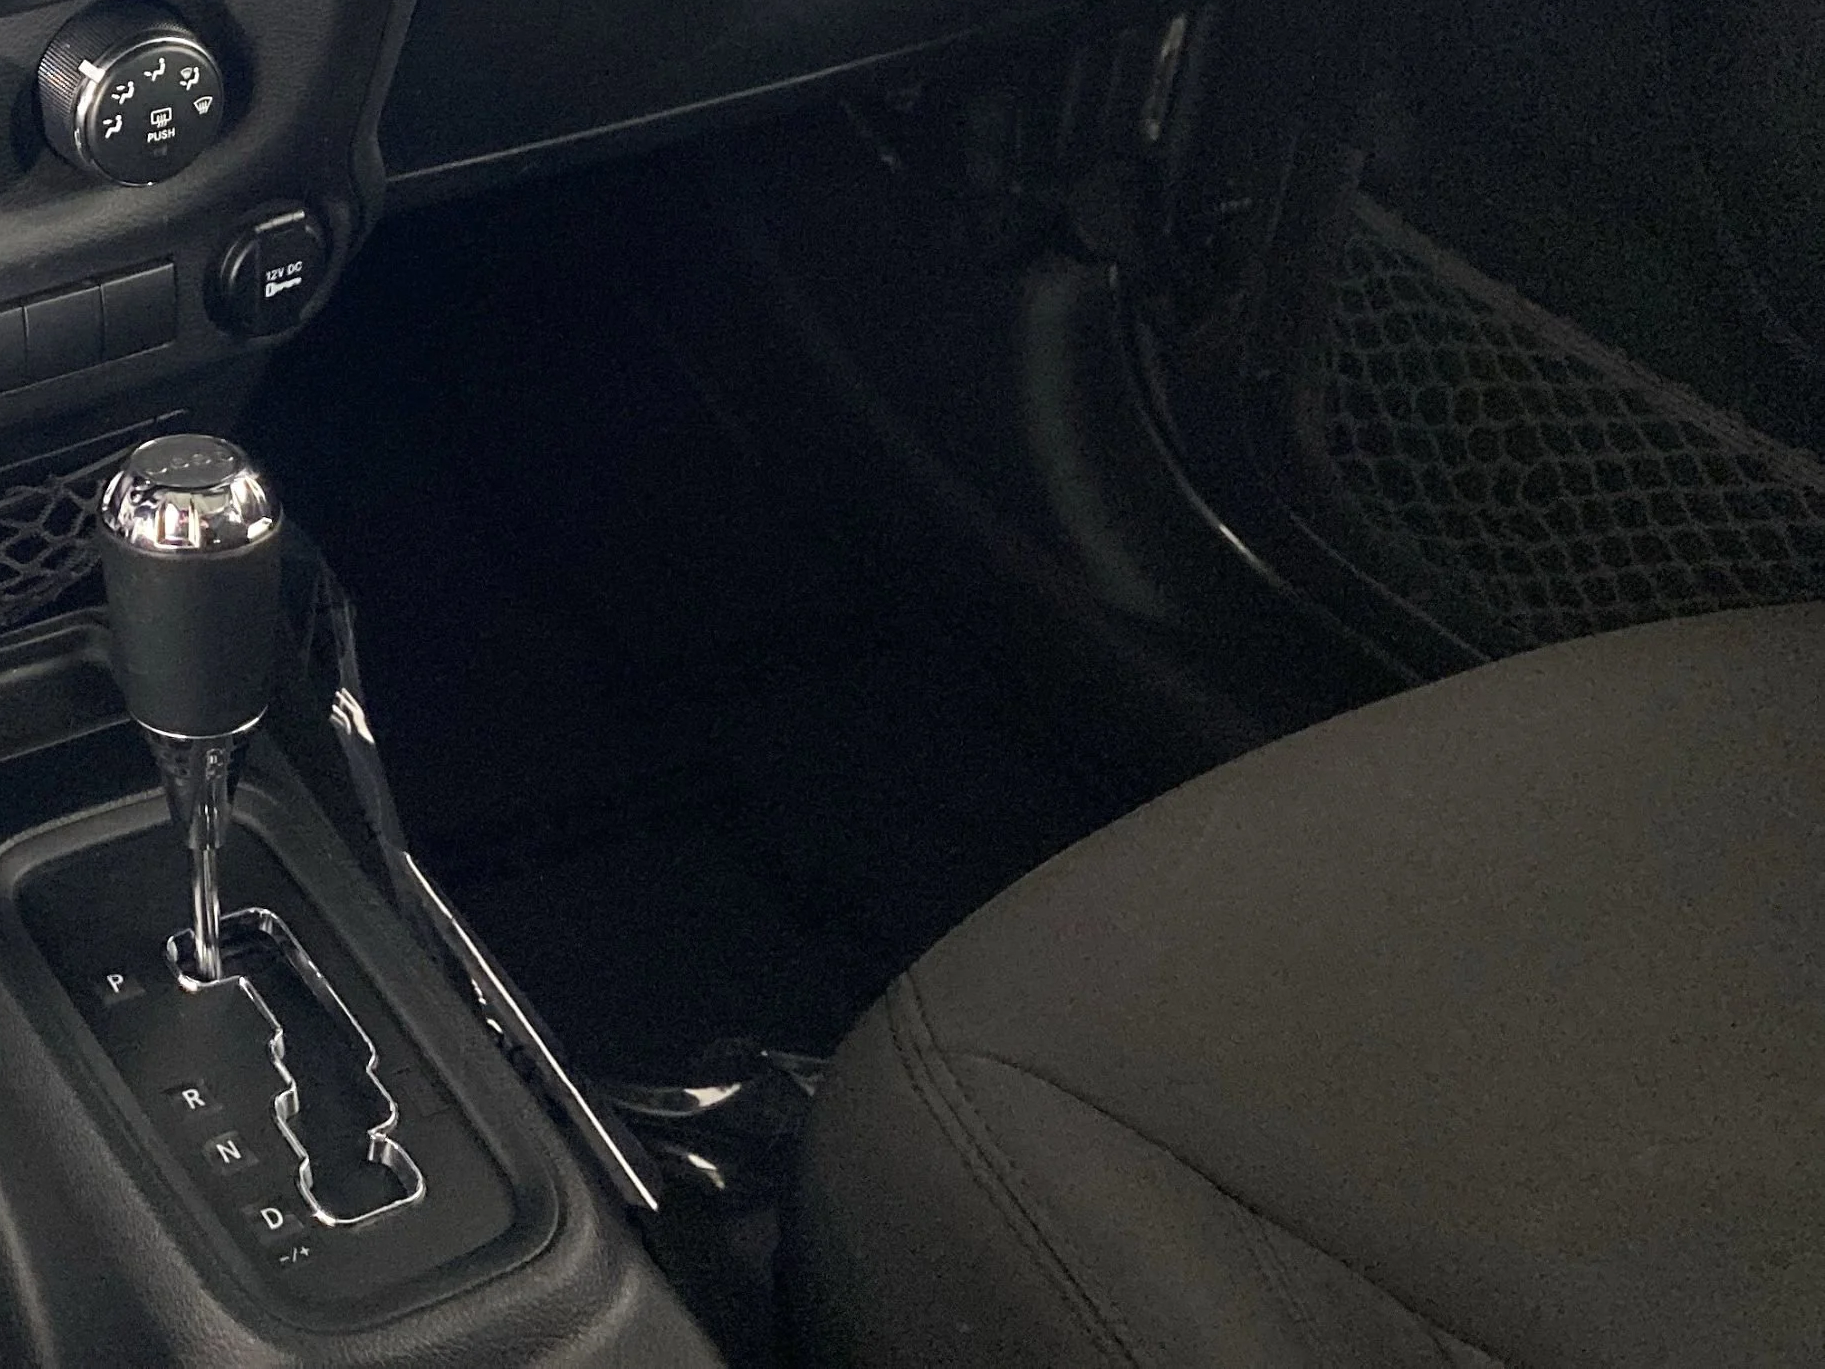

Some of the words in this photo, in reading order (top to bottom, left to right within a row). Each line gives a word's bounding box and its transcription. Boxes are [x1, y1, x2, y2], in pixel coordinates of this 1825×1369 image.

[147, 127, 176, 143] PUSH
[266, 267, 284, 281] 12V
[287, 261, 303, 275] DC
[106, 973, 125, 993] P
[181, 1087, 207, 1110] R
[216, 1140, 243, 1164] N
[260, 1207, 285, 1231] D
